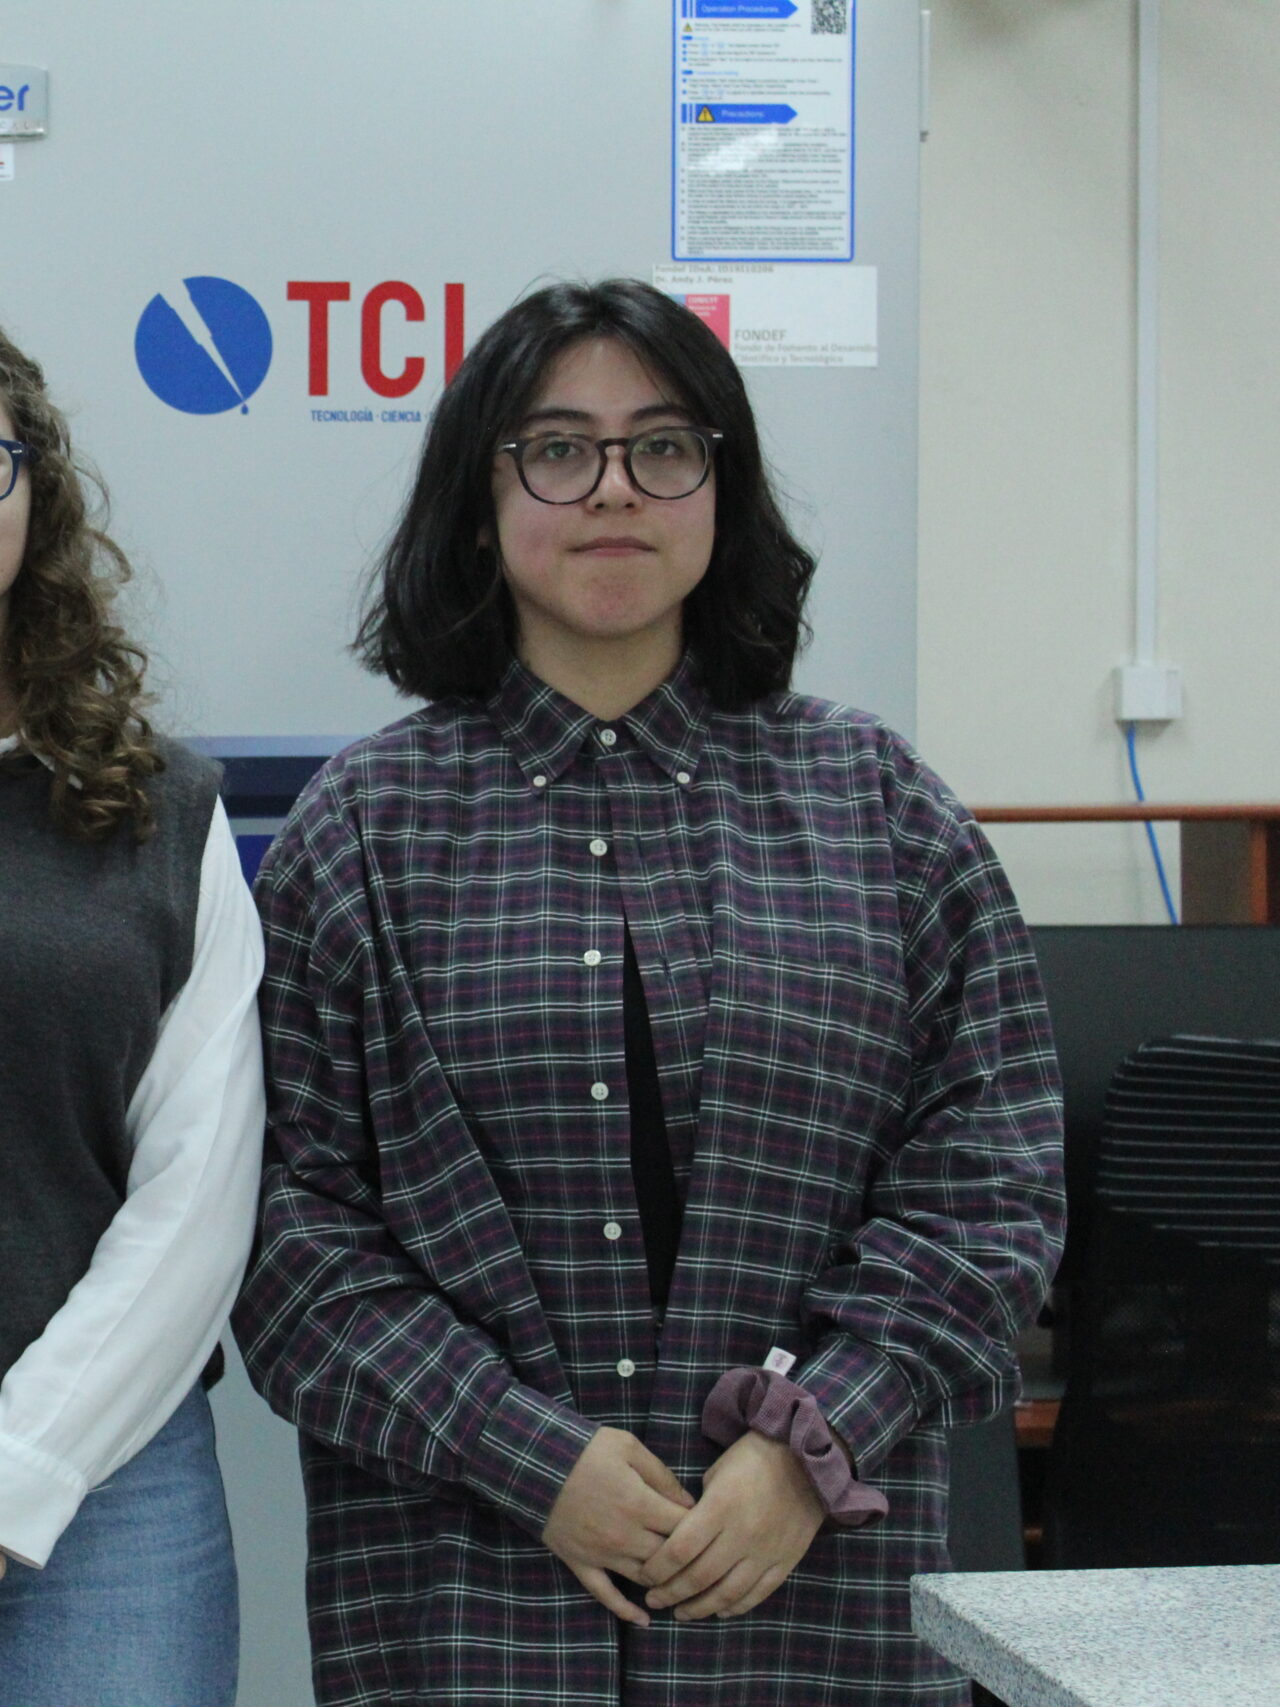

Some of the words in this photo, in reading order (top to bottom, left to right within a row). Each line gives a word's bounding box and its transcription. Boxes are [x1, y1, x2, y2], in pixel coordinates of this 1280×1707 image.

[671, 275, 693, 285] Andy
[734, 329, 787, 341] FONDEF
[381, 410, 421, 422] CIENCIA
